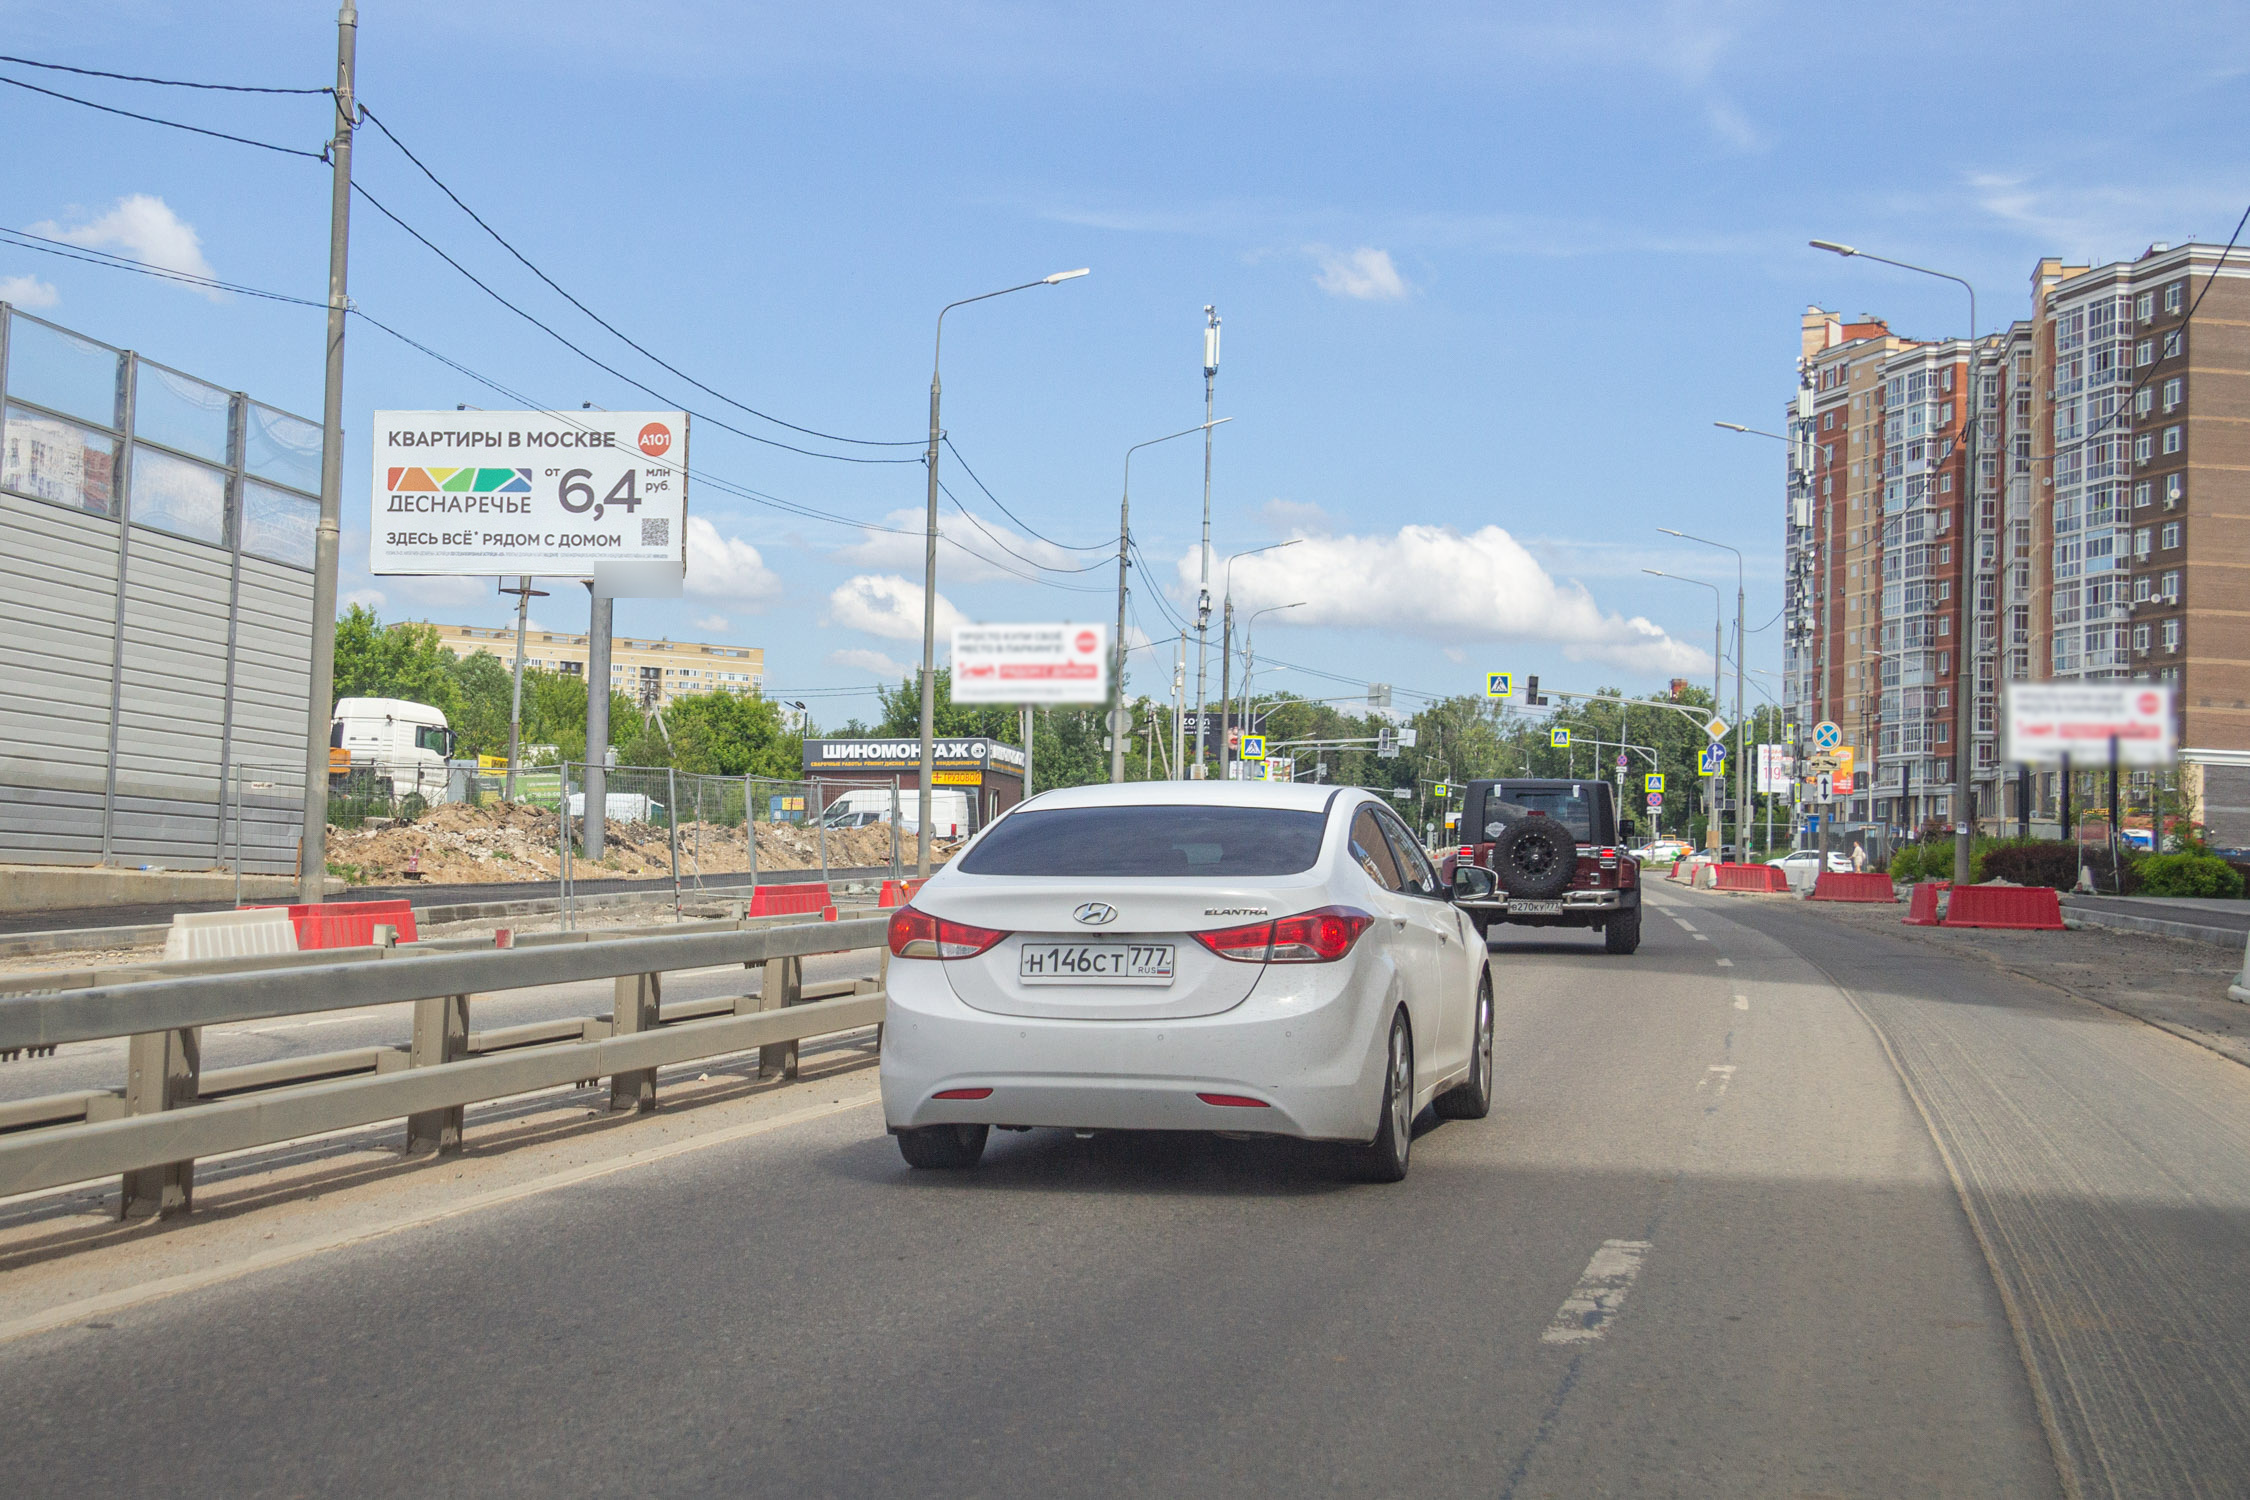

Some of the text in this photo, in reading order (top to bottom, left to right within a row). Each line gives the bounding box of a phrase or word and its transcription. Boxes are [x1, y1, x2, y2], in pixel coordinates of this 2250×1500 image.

[388, 431, 616, 448] КВАРТИРЫ В МОСКВЕ
[640, 433, 669, 446] А101
[646, 468, 671, 477] млн
[645, 480, 671, 493] руб.
[545, 468, 642, 522] от 6,4
[387, 495, 532, 514] ДЕСНАРЕЧЬЕ
[386, 532, 438, 546] ЗДЕСЬ
[483, 533, 540, 548] РЯДОМ
[544, 533, 555, 546] С
[558, 534, 622, 549] ДОМОМ
[943, 771, 981, 783] ГРУЗОВОЙ
[1204, 907, 1268, 916] ELANTRA
[1029, 947, 1167, 973] Н146СТ 777
[1138, 966, 1156, 974] RUS
